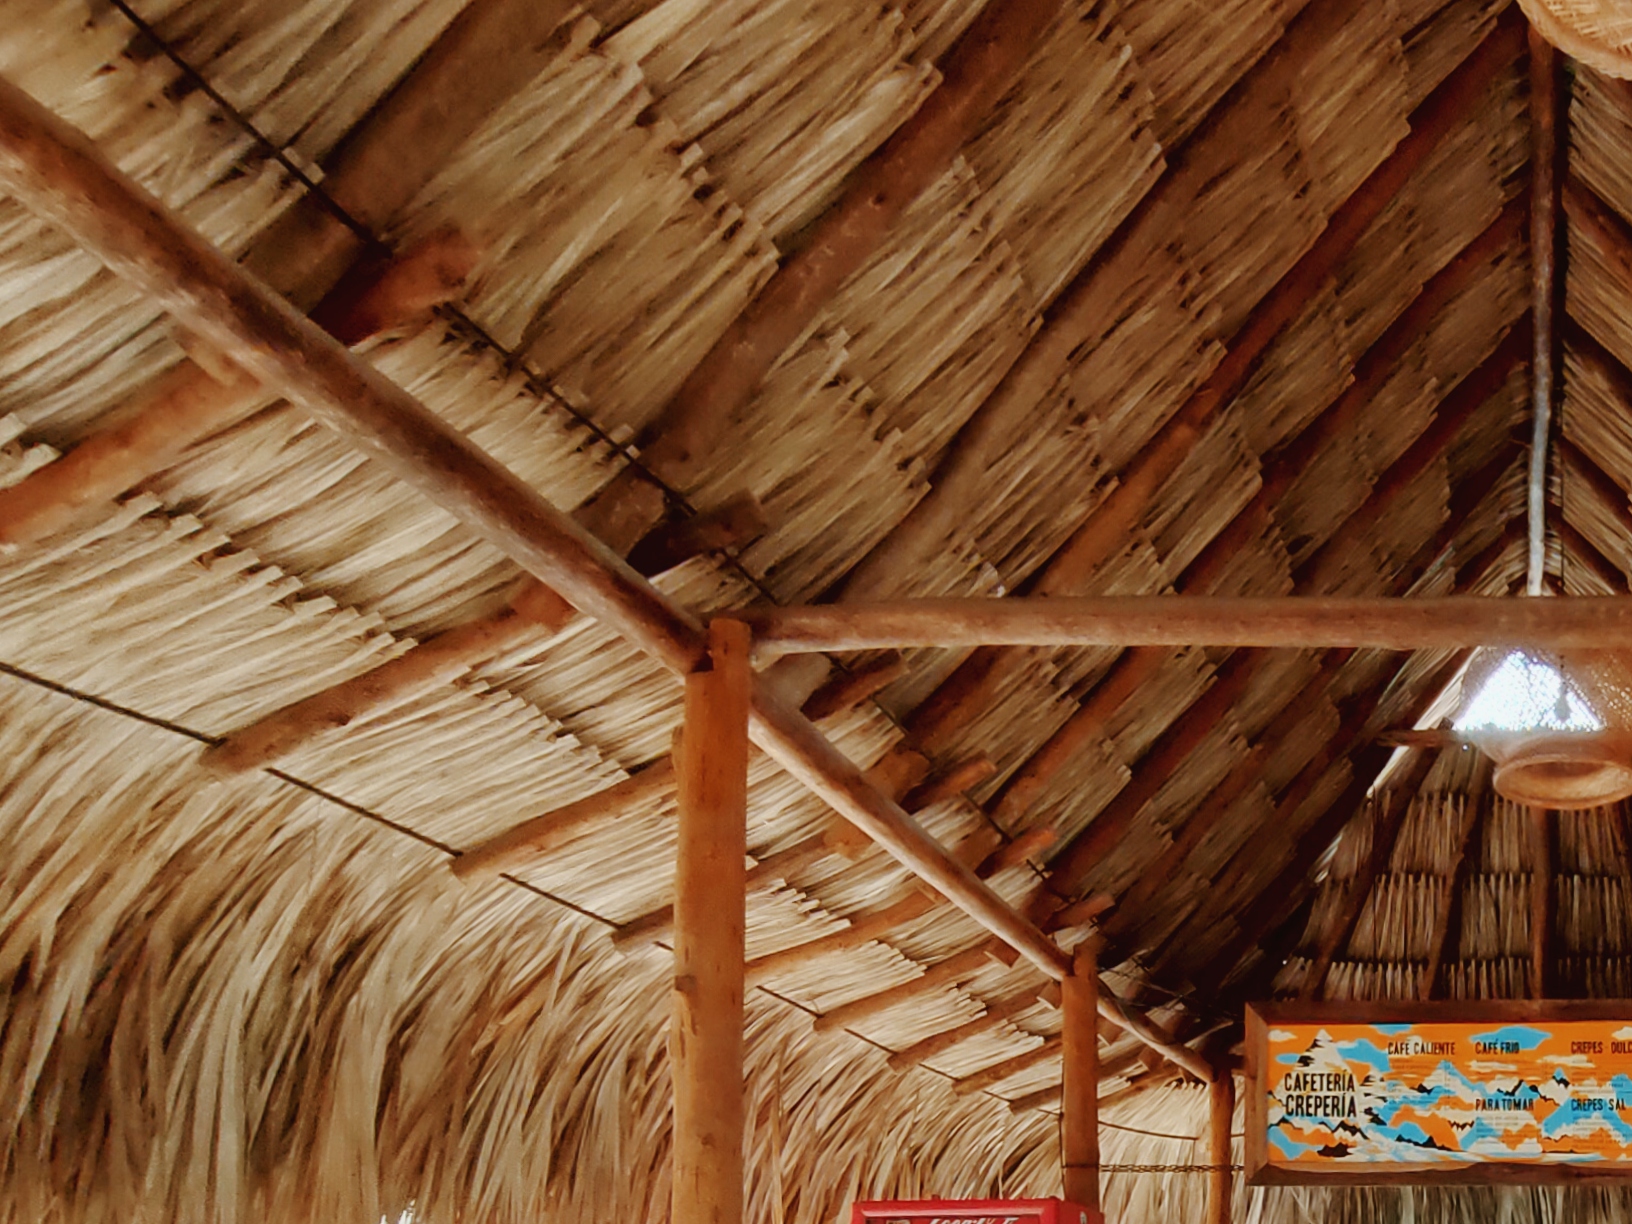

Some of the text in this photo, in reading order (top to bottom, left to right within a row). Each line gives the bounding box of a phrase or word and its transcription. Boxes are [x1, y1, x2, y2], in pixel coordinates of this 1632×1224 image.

[1414, 1042, 1455, 1055] CALIENTE
[1475, 1038, 1499, 1055] CAFÉ
[1571, 1041, 1603, 1054] CREPES
[1284, 1069, 1356, 1092] CAFETERÍA
[1285, 1092, 1357, 1117] CREPERÍA
[1475, 1098, 1535, 1112] PARA TOMAR
[1571, 1098, 1626, 1111] CREPES SAL
